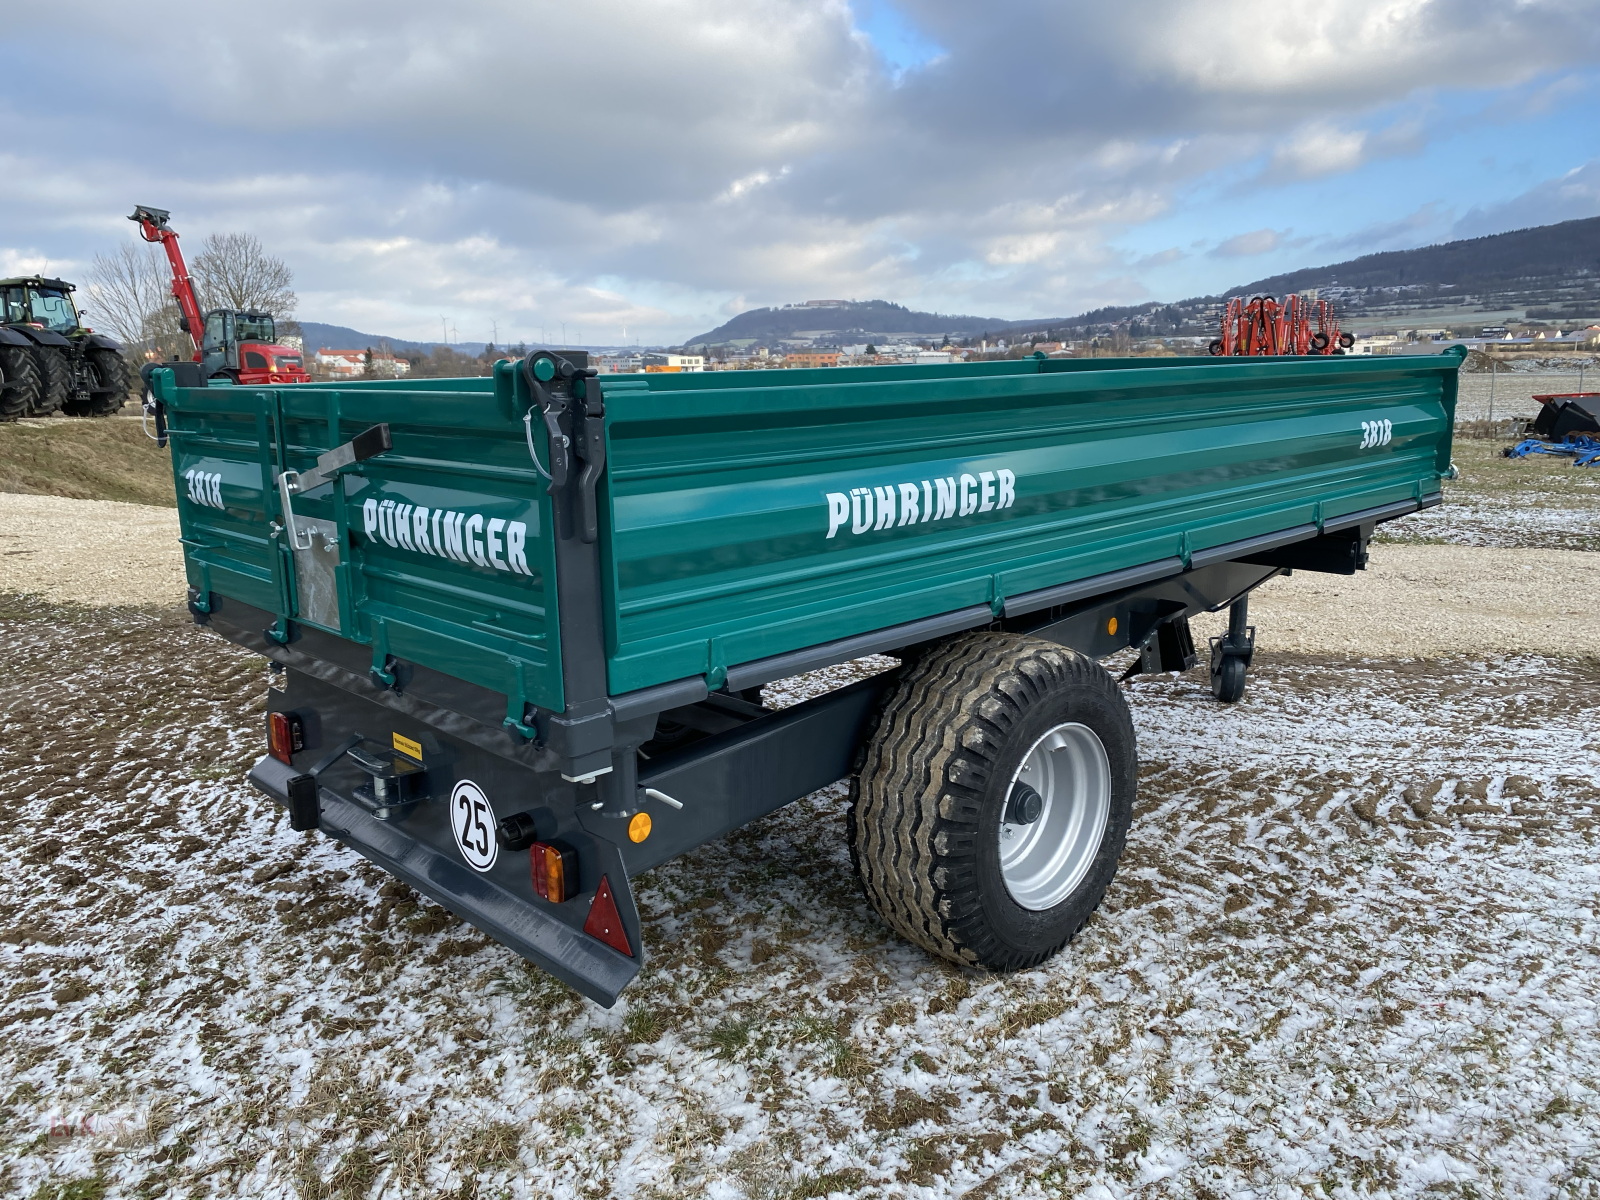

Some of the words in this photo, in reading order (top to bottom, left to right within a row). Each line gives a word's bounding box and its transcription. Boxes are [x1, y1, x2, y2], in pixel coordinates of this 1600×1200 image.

[1360, 419, 1392, 449] 3818
[185, 470, 226, 511] 3818
[826, 469, 1016, 539] PÜHRINGER
[363, 498, 534, 577] PÜHRINGER
[459, 794, 489, 857] 25
